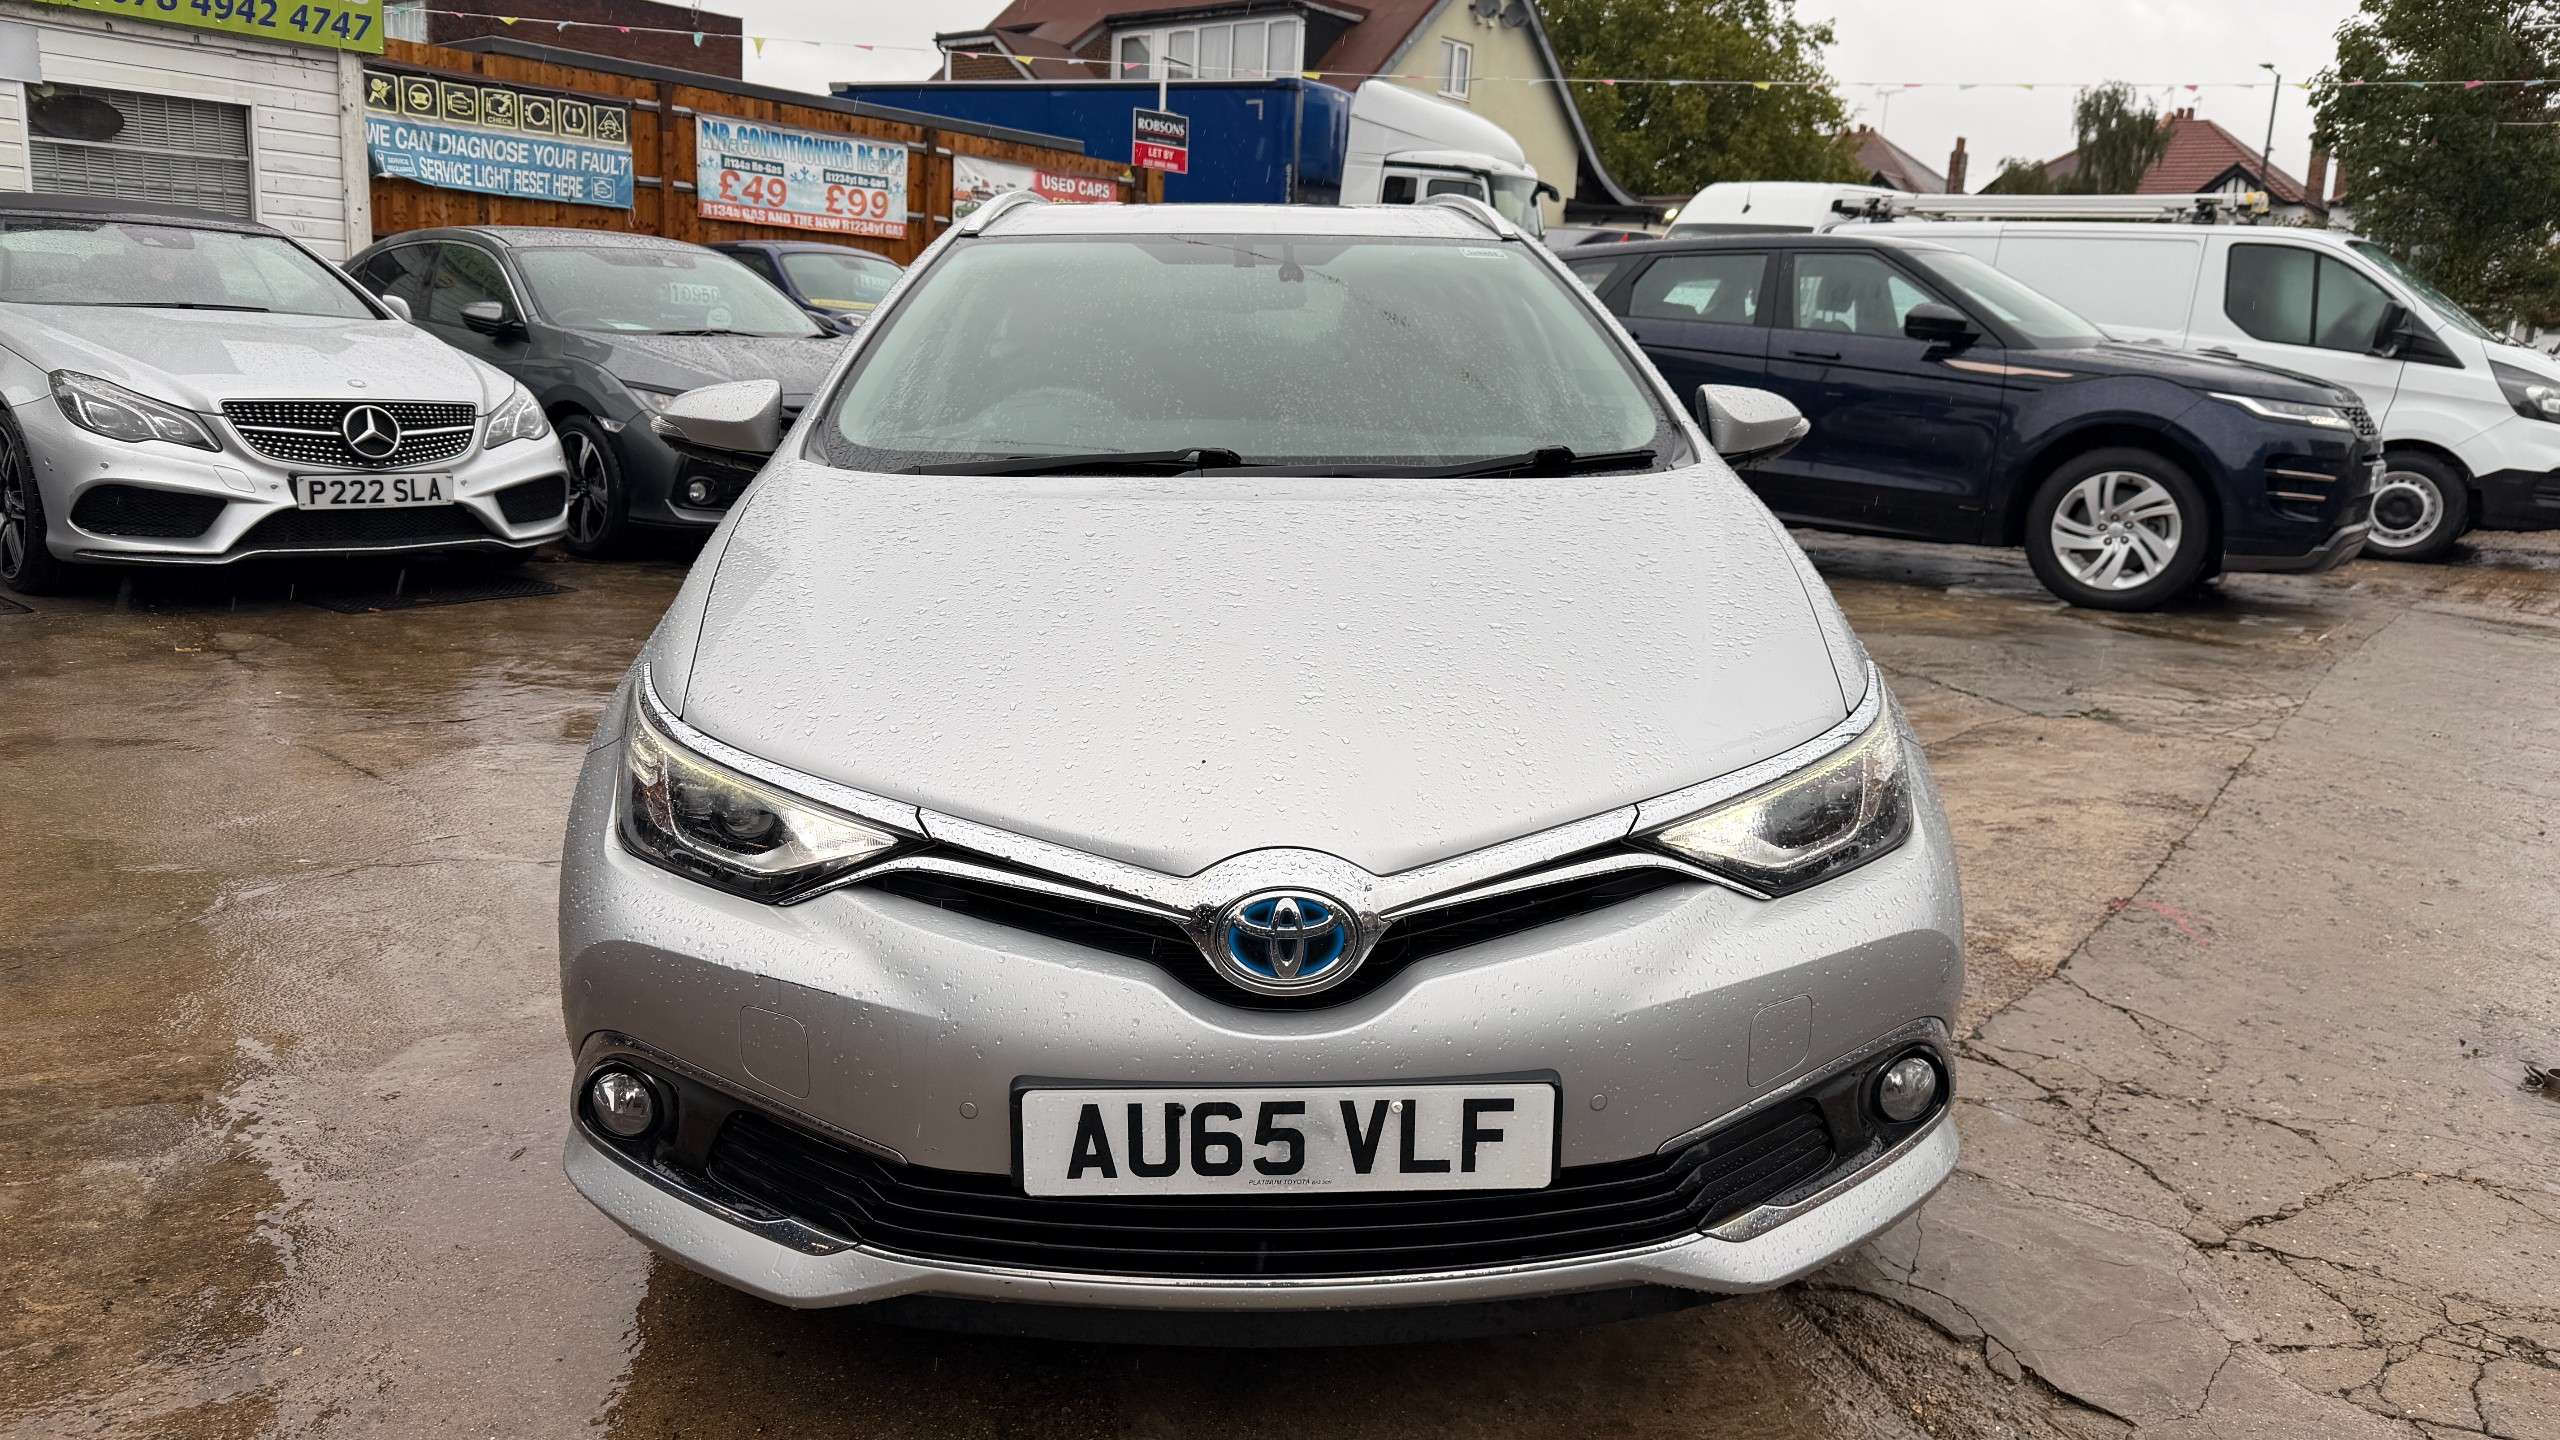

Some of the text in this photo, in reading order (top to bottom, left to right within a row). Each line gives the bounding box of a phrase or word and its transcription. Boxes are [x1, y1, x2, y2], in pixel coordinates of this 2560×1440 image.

[289, 4, 373, 41] 4747
[487, 116, 513, 126] CHECK
[1137, 117, 1185, 137] ROBSONS
[366, 122, 632, 176] WE CAN DIAGNOSE YOUR FAULT
[1147, 146, 1175, 160] LET BY
[419, 156, 585, 198] SERVICE LIGHT RESET HERE
[719, 169, 788, 208] £49
[1041, 174, 1110, 199] USED CARS
[825, 184, 889, 219] £99
[742, 208, 766, 222] GAS
[767, 211, 791, 225] AND
[793, 214, 814, 228] THE
[814, 217, 841, 232] NEW
[884, 224, 904, 238] GAS
[308, 477, 442, 505] P222 SLA
[1066, 1098, 1515, 1179] AU65 VLF
[1283, 1178, 1310, 1186] TOYOTA
